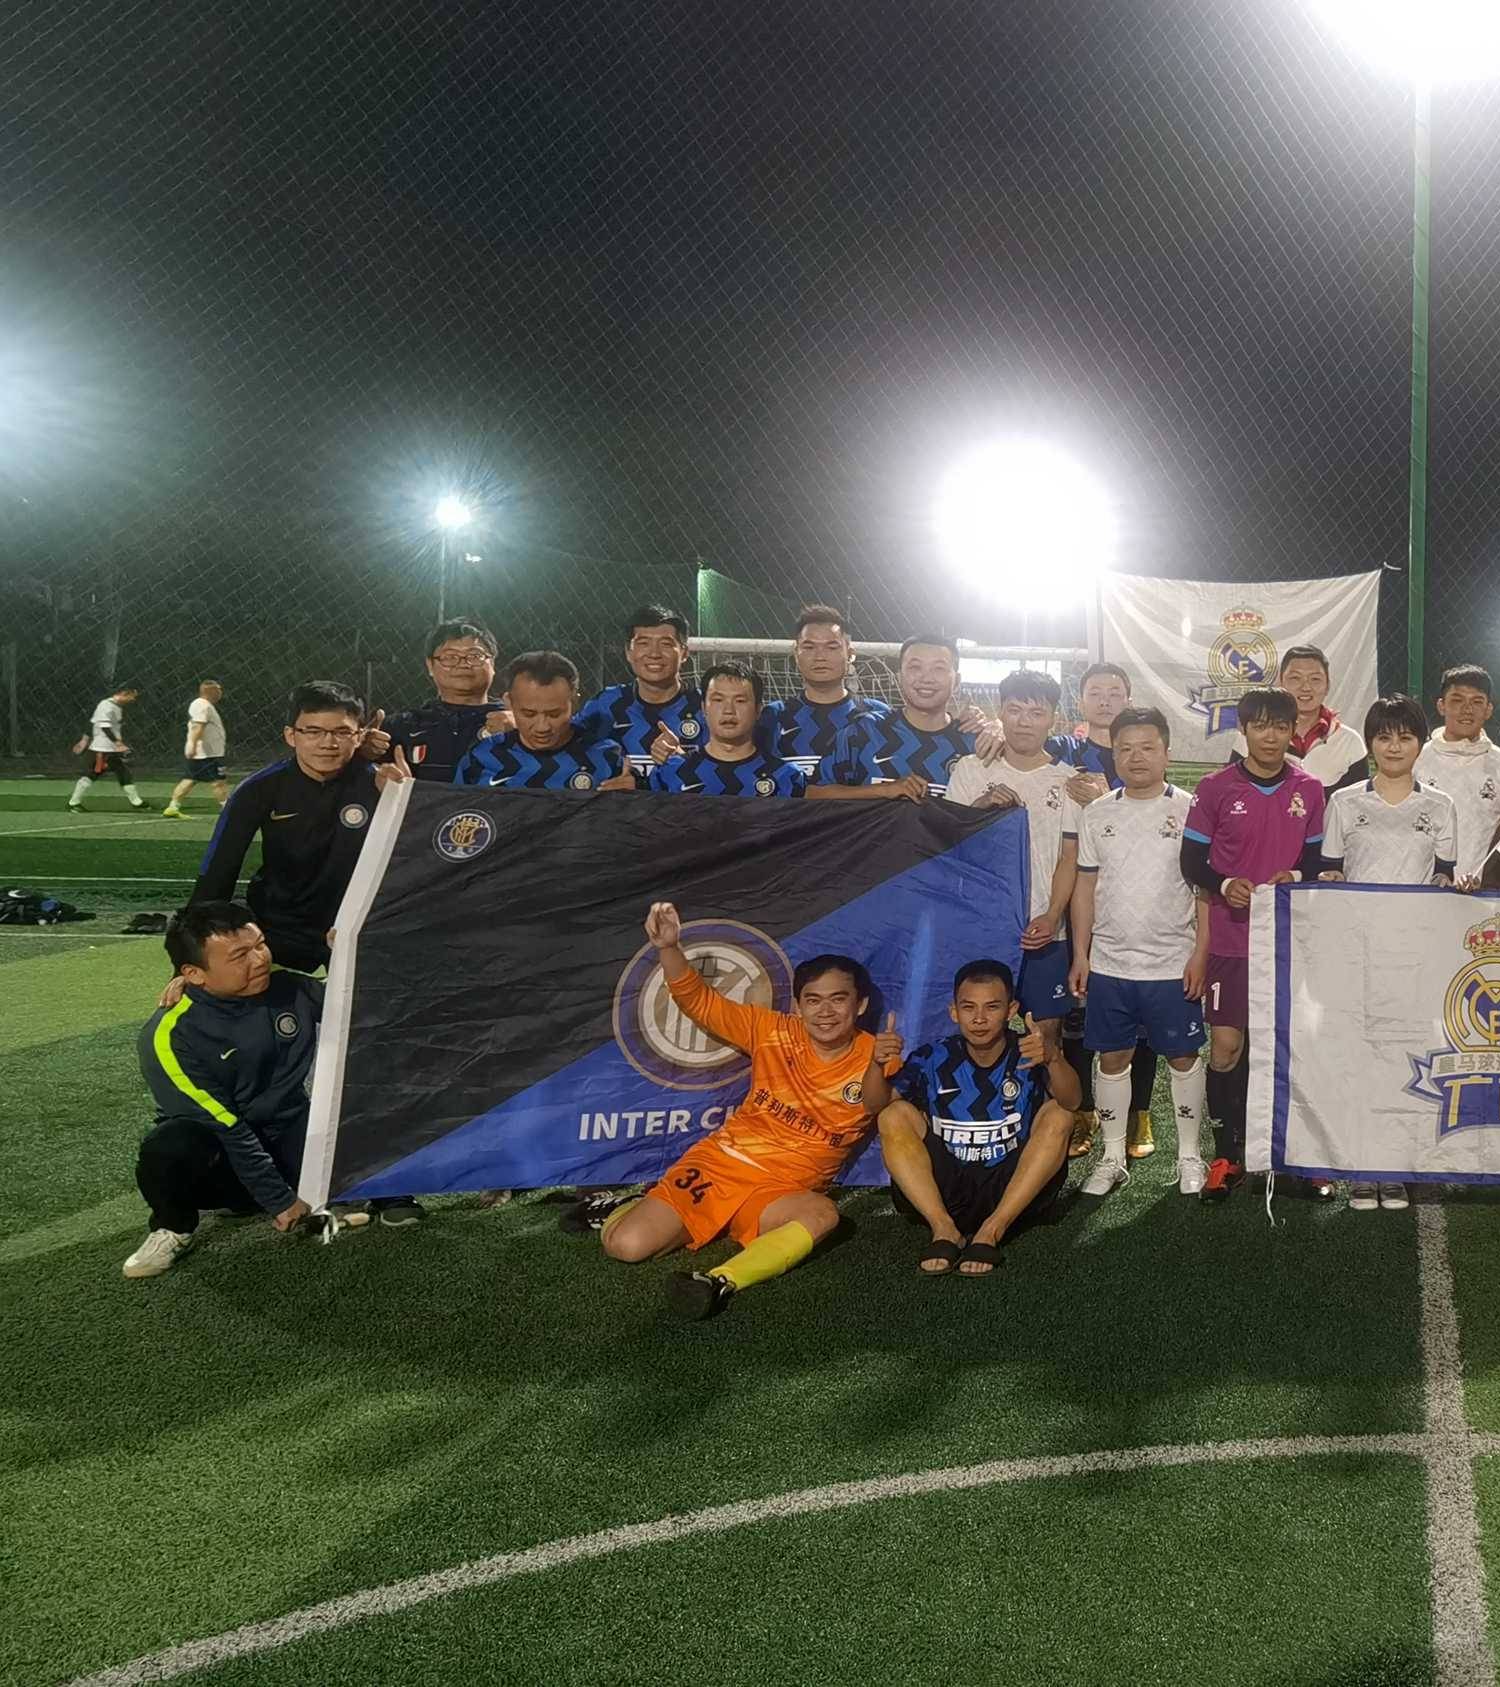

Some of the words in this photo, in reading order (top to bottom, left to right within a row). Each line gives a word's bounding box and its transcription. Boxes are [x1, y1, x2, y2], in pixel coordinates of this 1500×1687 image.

[1210, 981, 1221, 1011] 1
[579, 1109, 691, 1141] INTER
[674, 1167, 713, 1205] 34
